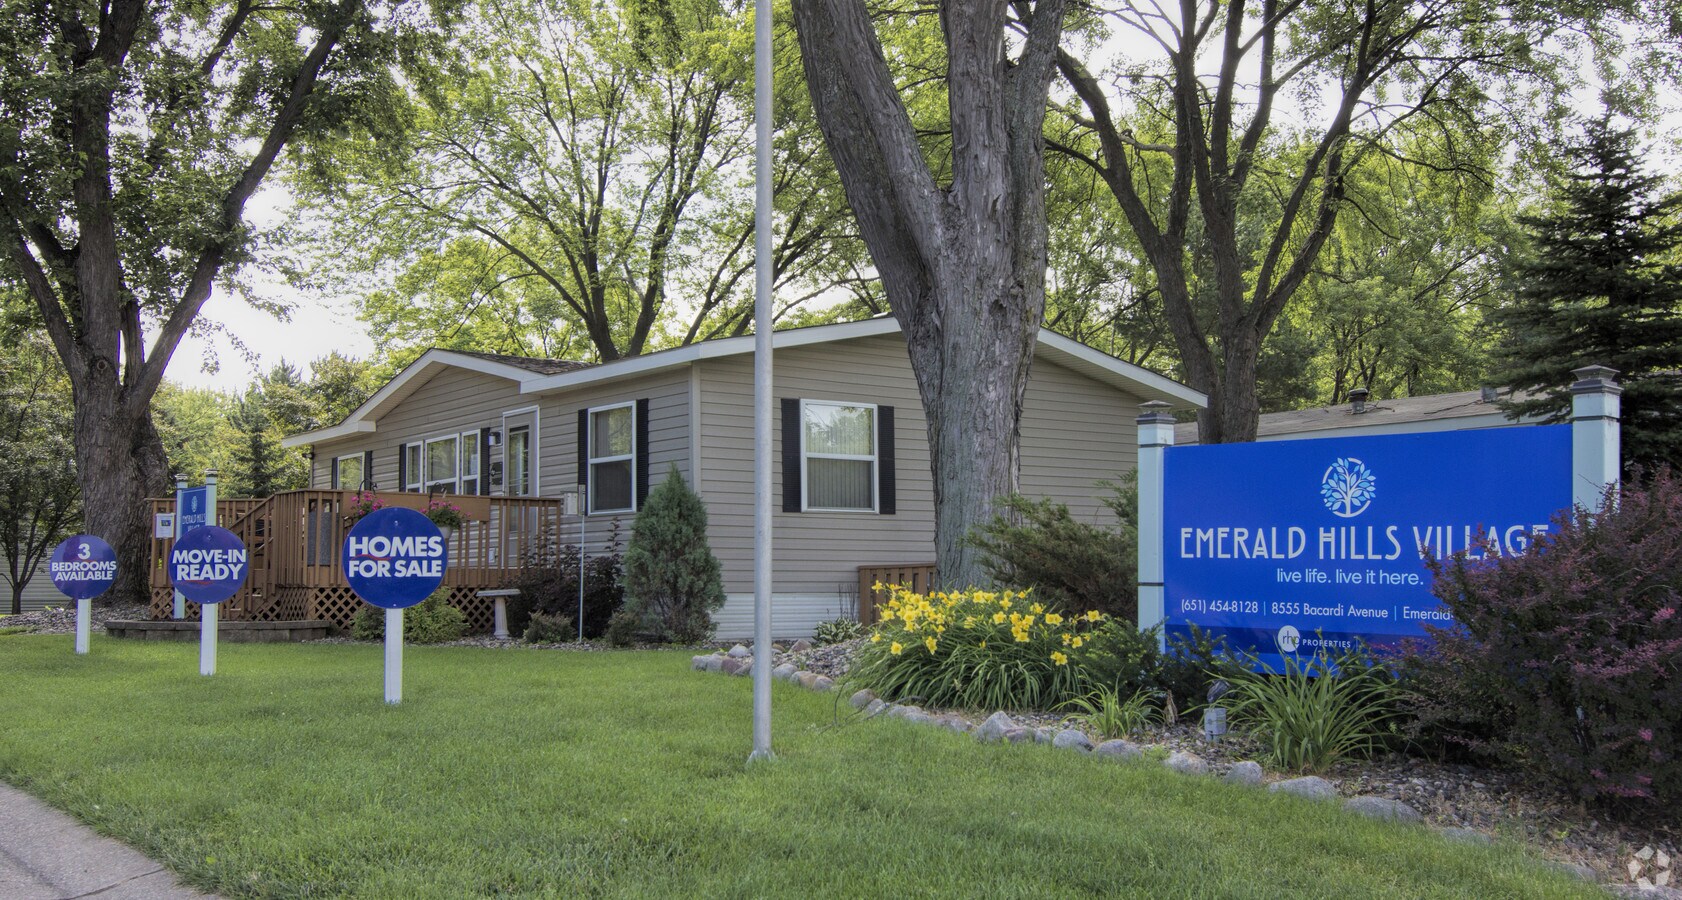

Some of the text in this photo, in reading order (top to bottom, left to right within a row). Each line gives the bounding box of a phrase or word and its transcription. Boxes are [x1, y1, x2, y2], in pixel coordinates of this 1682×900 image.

[77, 543, 91, 560] 3
[349, 536, 443, 557] HOMES
[1181, 526, 1306, 559] EMERALD
[1319, 526, 1401, 560] HILLS
[172, 549, 247, 564] MOVE-IN
[51, 561, 117, 572] BEDROOMS
[176, 563, 243, 581] READY
[349, 560, 442, 578] FOR SALE
[55, 571, 113, 581] AVAILABLE
[1276, 567, 1424, 586] live life. live it here.
[1181, 599, 1454, 620] (651) 454-8128 8555 Bacardi Avenue Emerald
[1302, 638, 1351, 649] PROPERTIES
